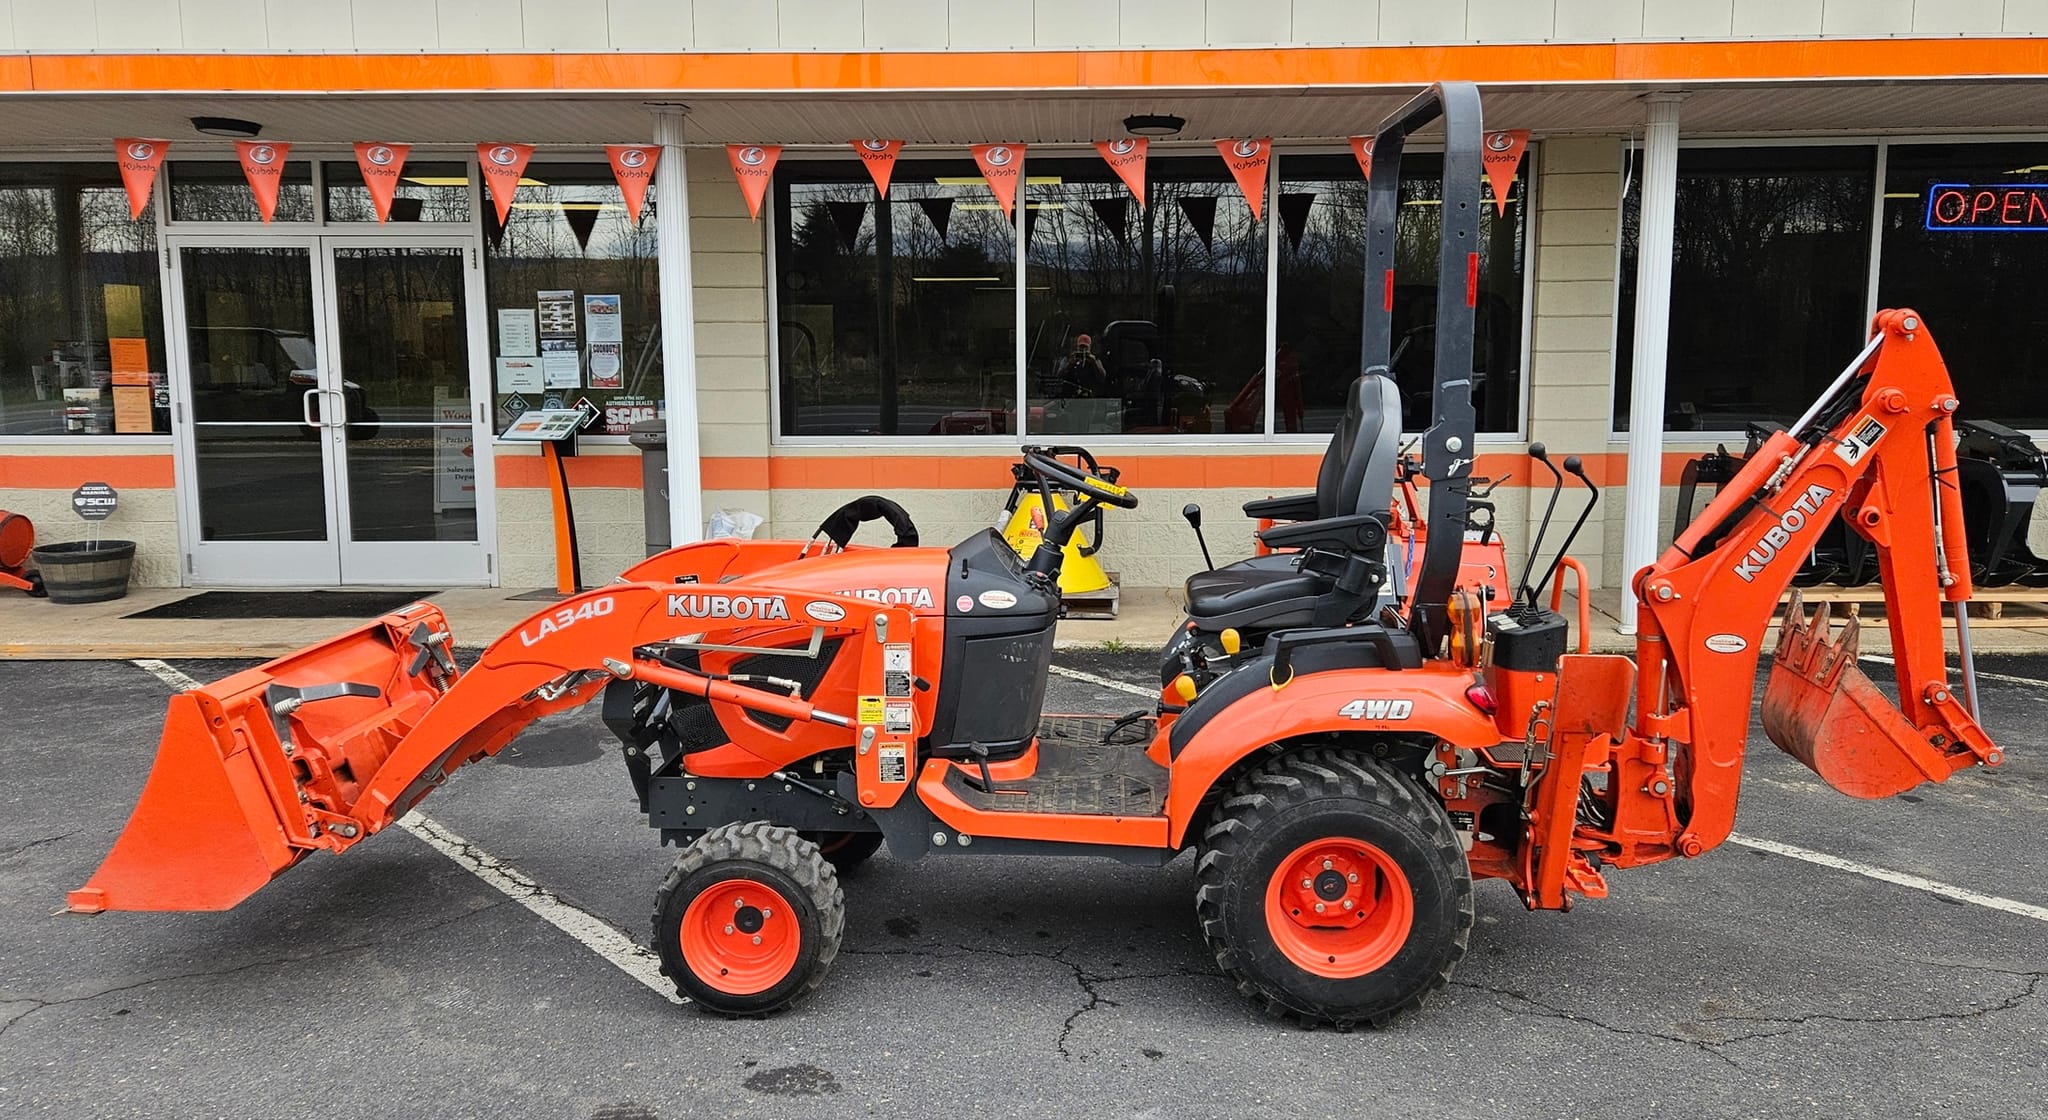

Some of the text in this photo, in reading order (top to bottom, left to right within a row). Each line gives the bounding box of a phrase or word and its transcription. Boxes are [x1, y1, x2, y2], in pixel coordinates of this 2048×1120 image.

[860, 152, 893, 161] Kubota
[1110, 153, 1144, 167] Kubota
[122, 162, 156, 172] Kubota
[1233, 157, 1267, 171] Kubota
[246, 166, 280, 176] Kubota
[363, 167, 397, 177] Kubota
[484, 166, 519, 178] Kubota
[616, 169, 650, 179] Kubota
[735, 167, 769, 178] Kubota
[985, 167, 1017, 178] Kubota
[1936, 191, 2048, 223] OPEN
[1733, 483, 1836, 583] KUBOTA
[667, 594, 790, 620] KUBOTA
[519, 596, 615, 647] LA340
[1338, 699, 1415, 721] 4WD
